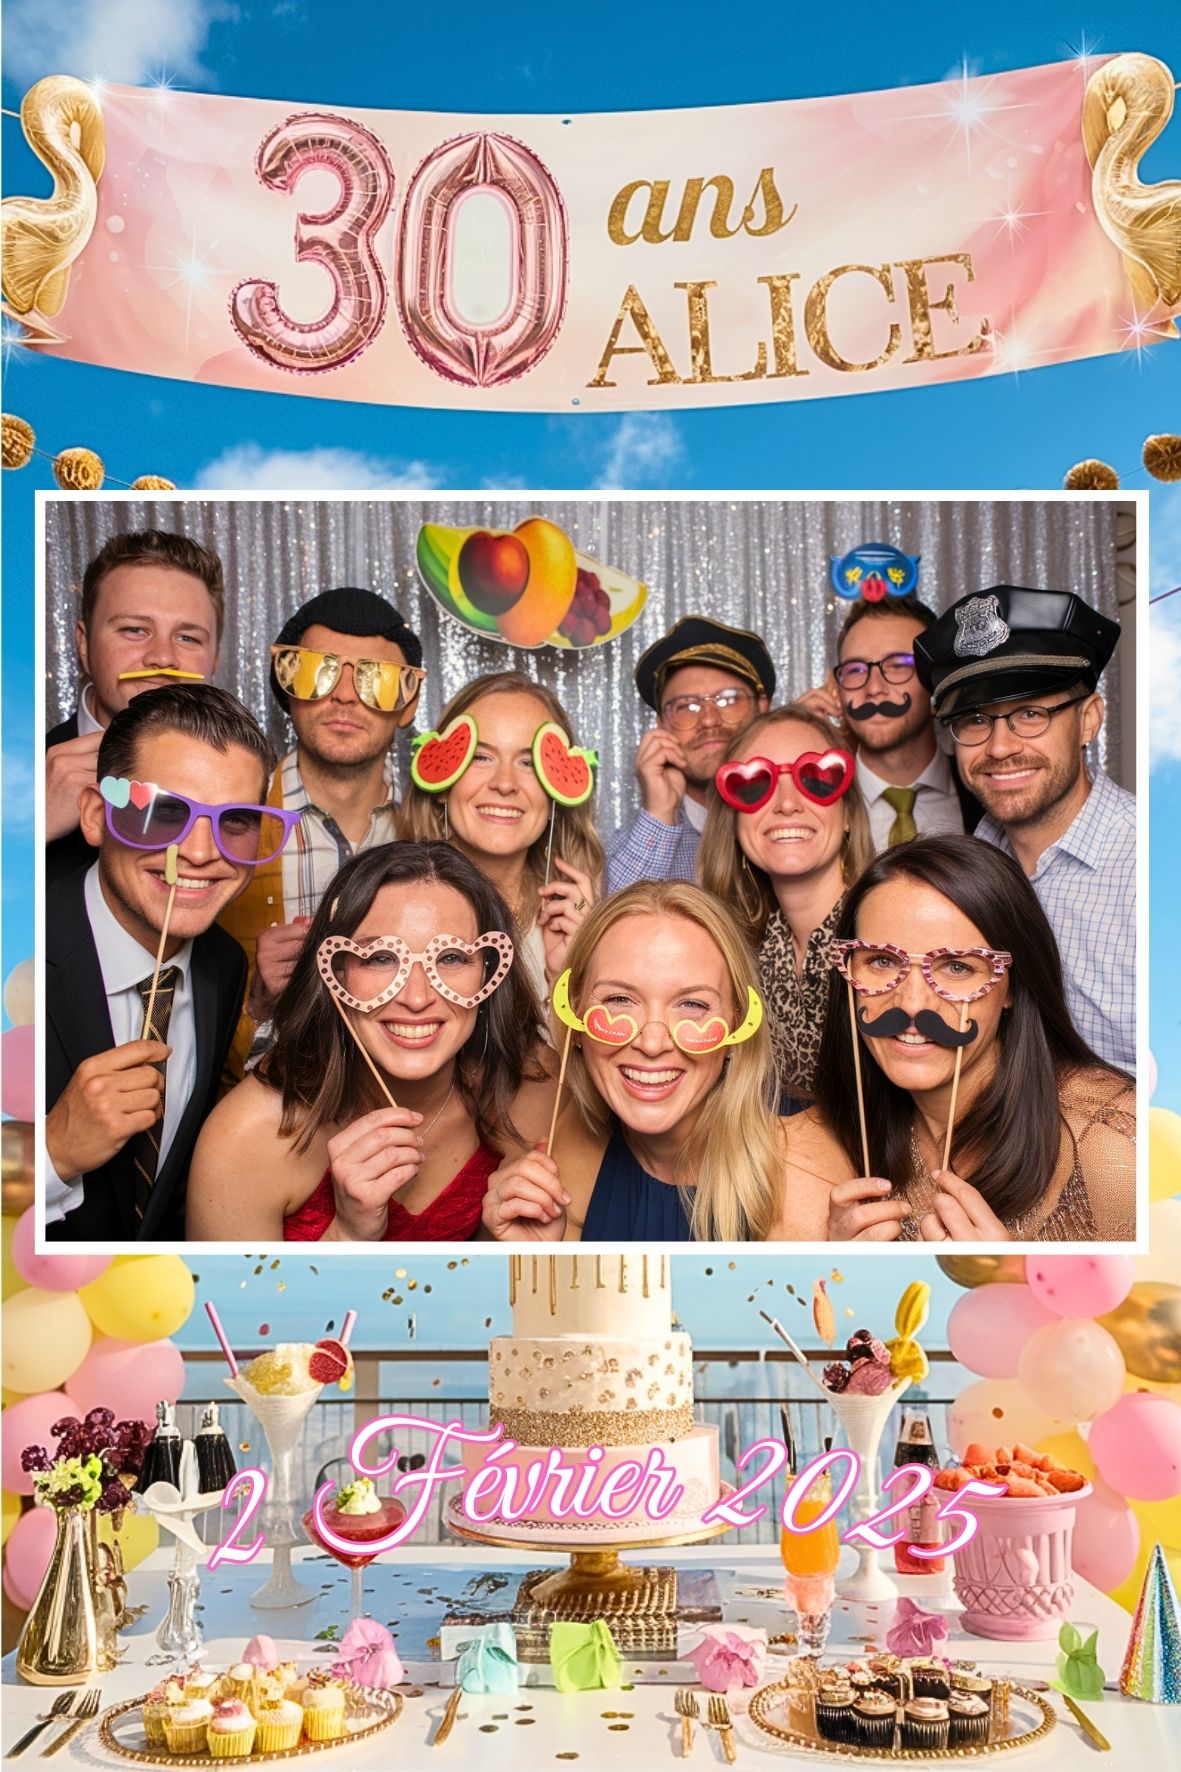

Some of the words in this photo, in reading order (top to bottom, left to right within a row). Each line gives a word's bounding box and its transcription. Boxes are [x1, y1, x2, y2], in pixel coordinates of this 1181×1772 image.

[228, 113, 569, 387] 30
[607, 166, 798, 245] ans
[586, 253, 990, 388] ALICE
